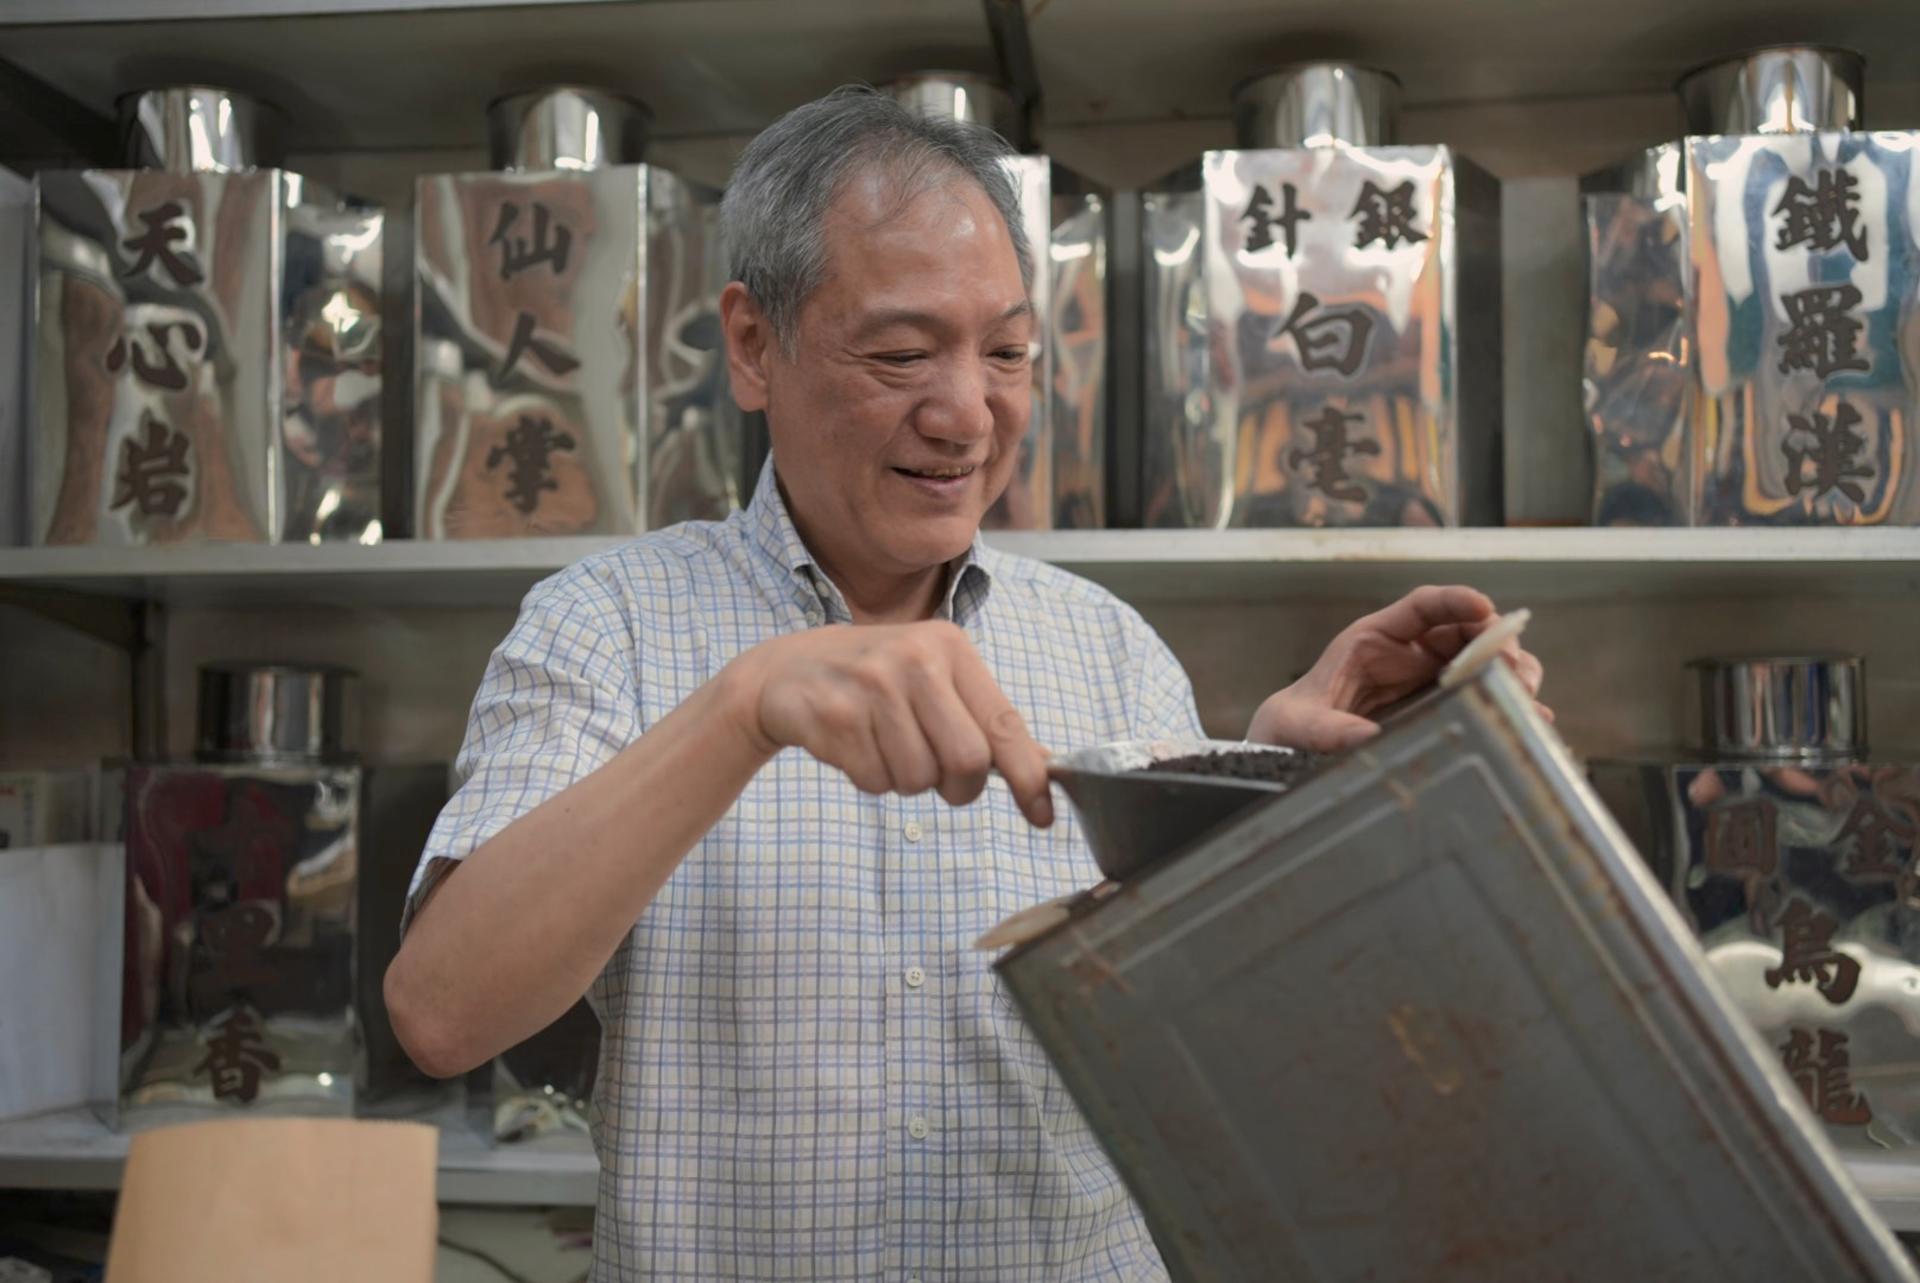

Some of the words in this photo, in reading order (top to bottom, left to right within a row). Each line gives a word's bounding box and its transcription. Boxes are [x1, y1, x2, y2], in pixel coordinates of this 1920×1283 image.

[107, 202, 204, 517] 天心岩
[485, 202, 580, 514] 仙人掌
[1771, 169, 1876, 502] 鐵羅漢
